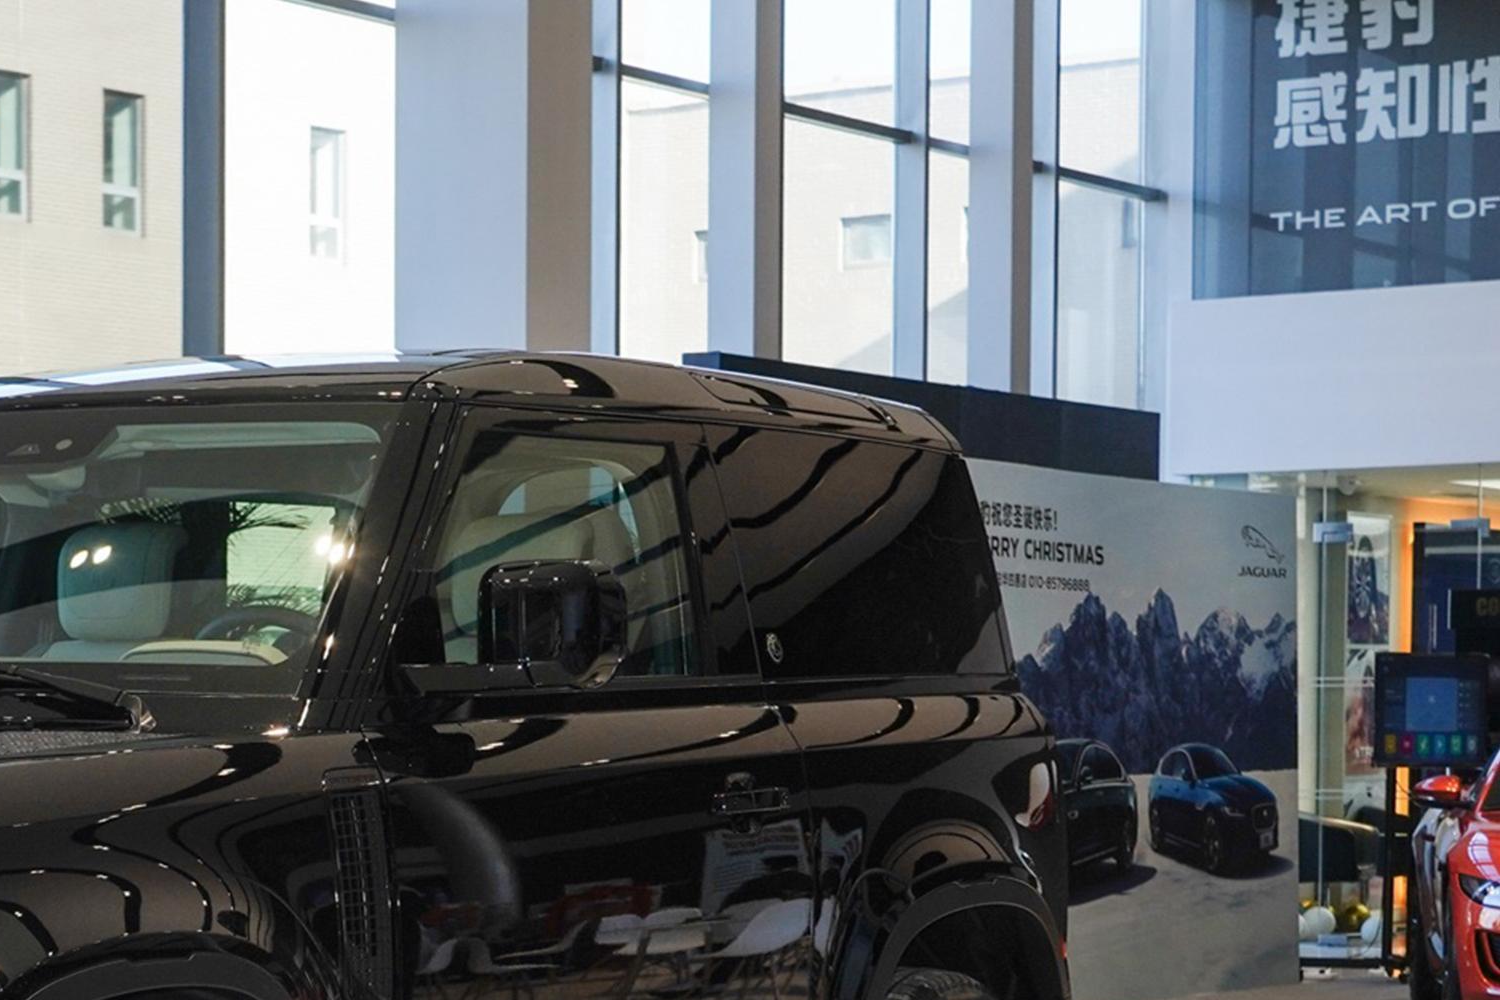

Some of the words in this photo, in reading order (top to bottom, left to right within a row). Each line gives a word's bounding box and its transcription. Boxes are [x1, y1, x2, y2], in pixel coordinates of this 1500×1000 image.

[1275, 0, 1435, 58] 捷豹
[1273, 55, 1500, 149] 感知性
[1269, 207, 1346, 232] THE
[1356, 202, 1437, 226] ART
[1447, 196, 1500, 219] OF
[988, 536, 1019, 558] RRY
[1024, 539, 1104, 566] CHRISTMAS
[1237, 565, 1287, 579] JAGUAR
